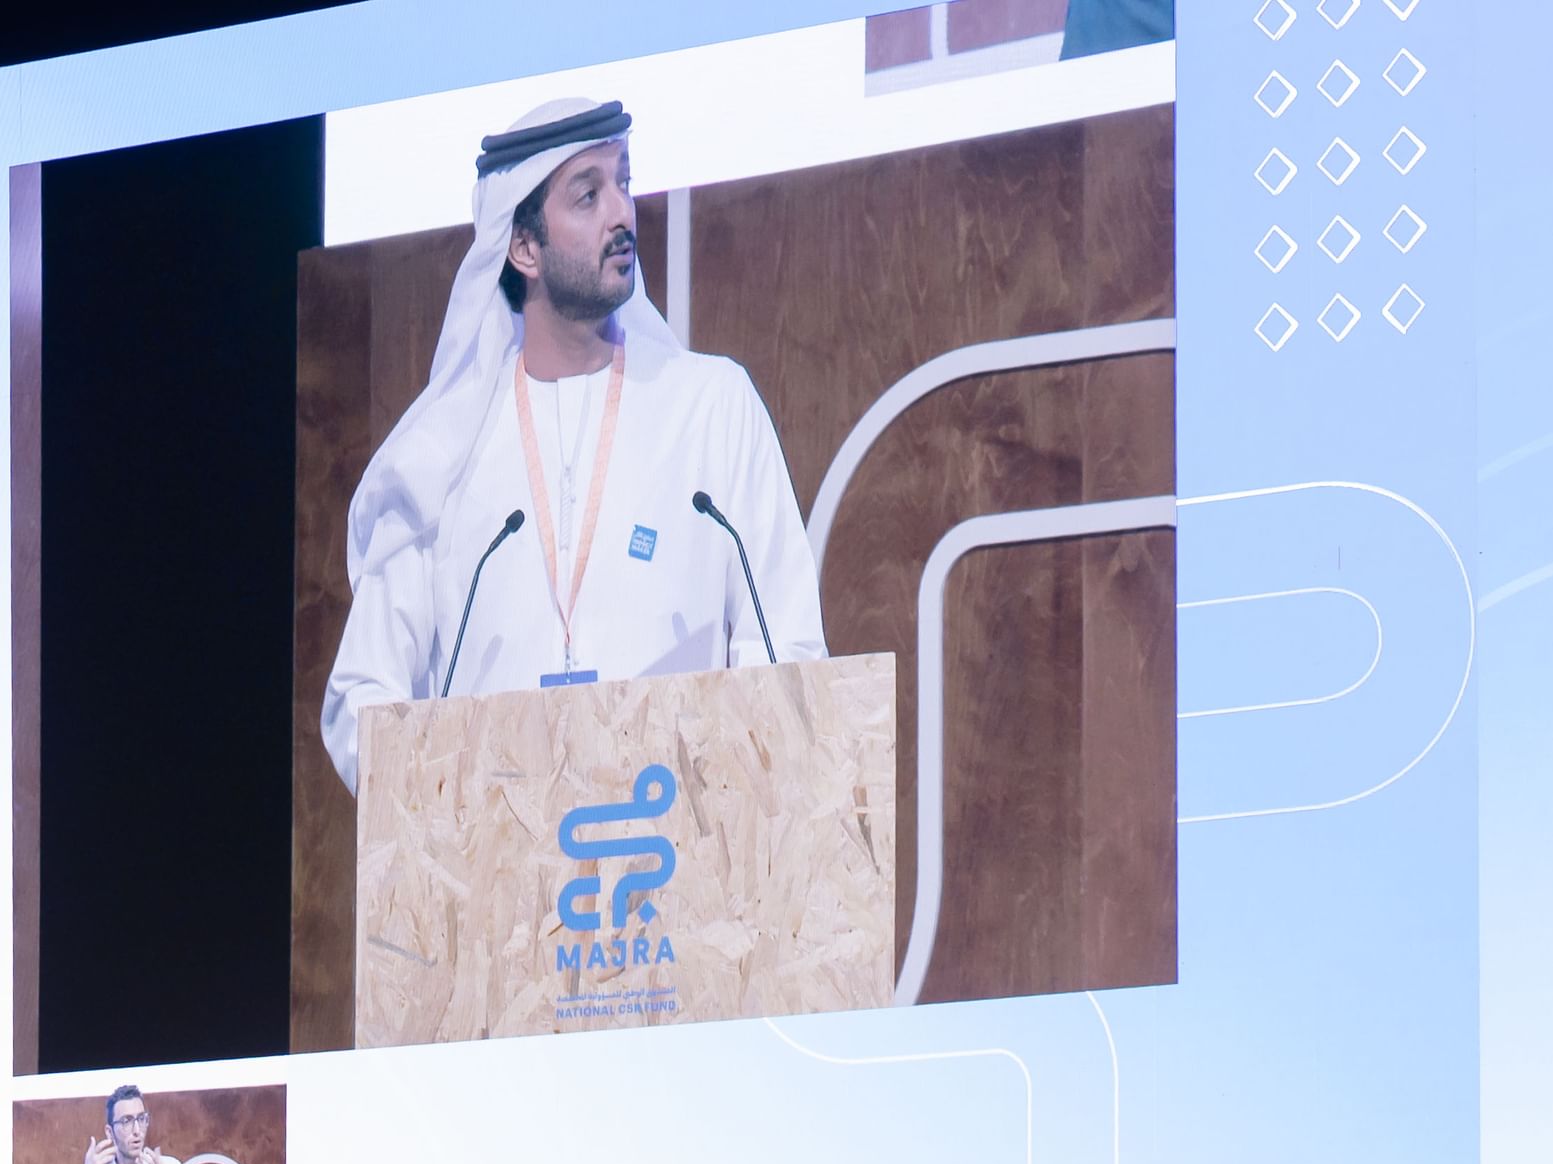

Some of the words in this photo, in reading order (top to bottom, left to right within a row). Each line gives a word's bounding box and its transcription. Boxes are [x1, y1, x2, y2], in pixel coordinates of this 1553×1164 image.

[556, 936, 675, 971] MAJRA
[556, 1004, 615, 1019] NATIONAL
[619, 1003, 641, 1014] CSR
[644, 1000, 676, 1012] FUND
